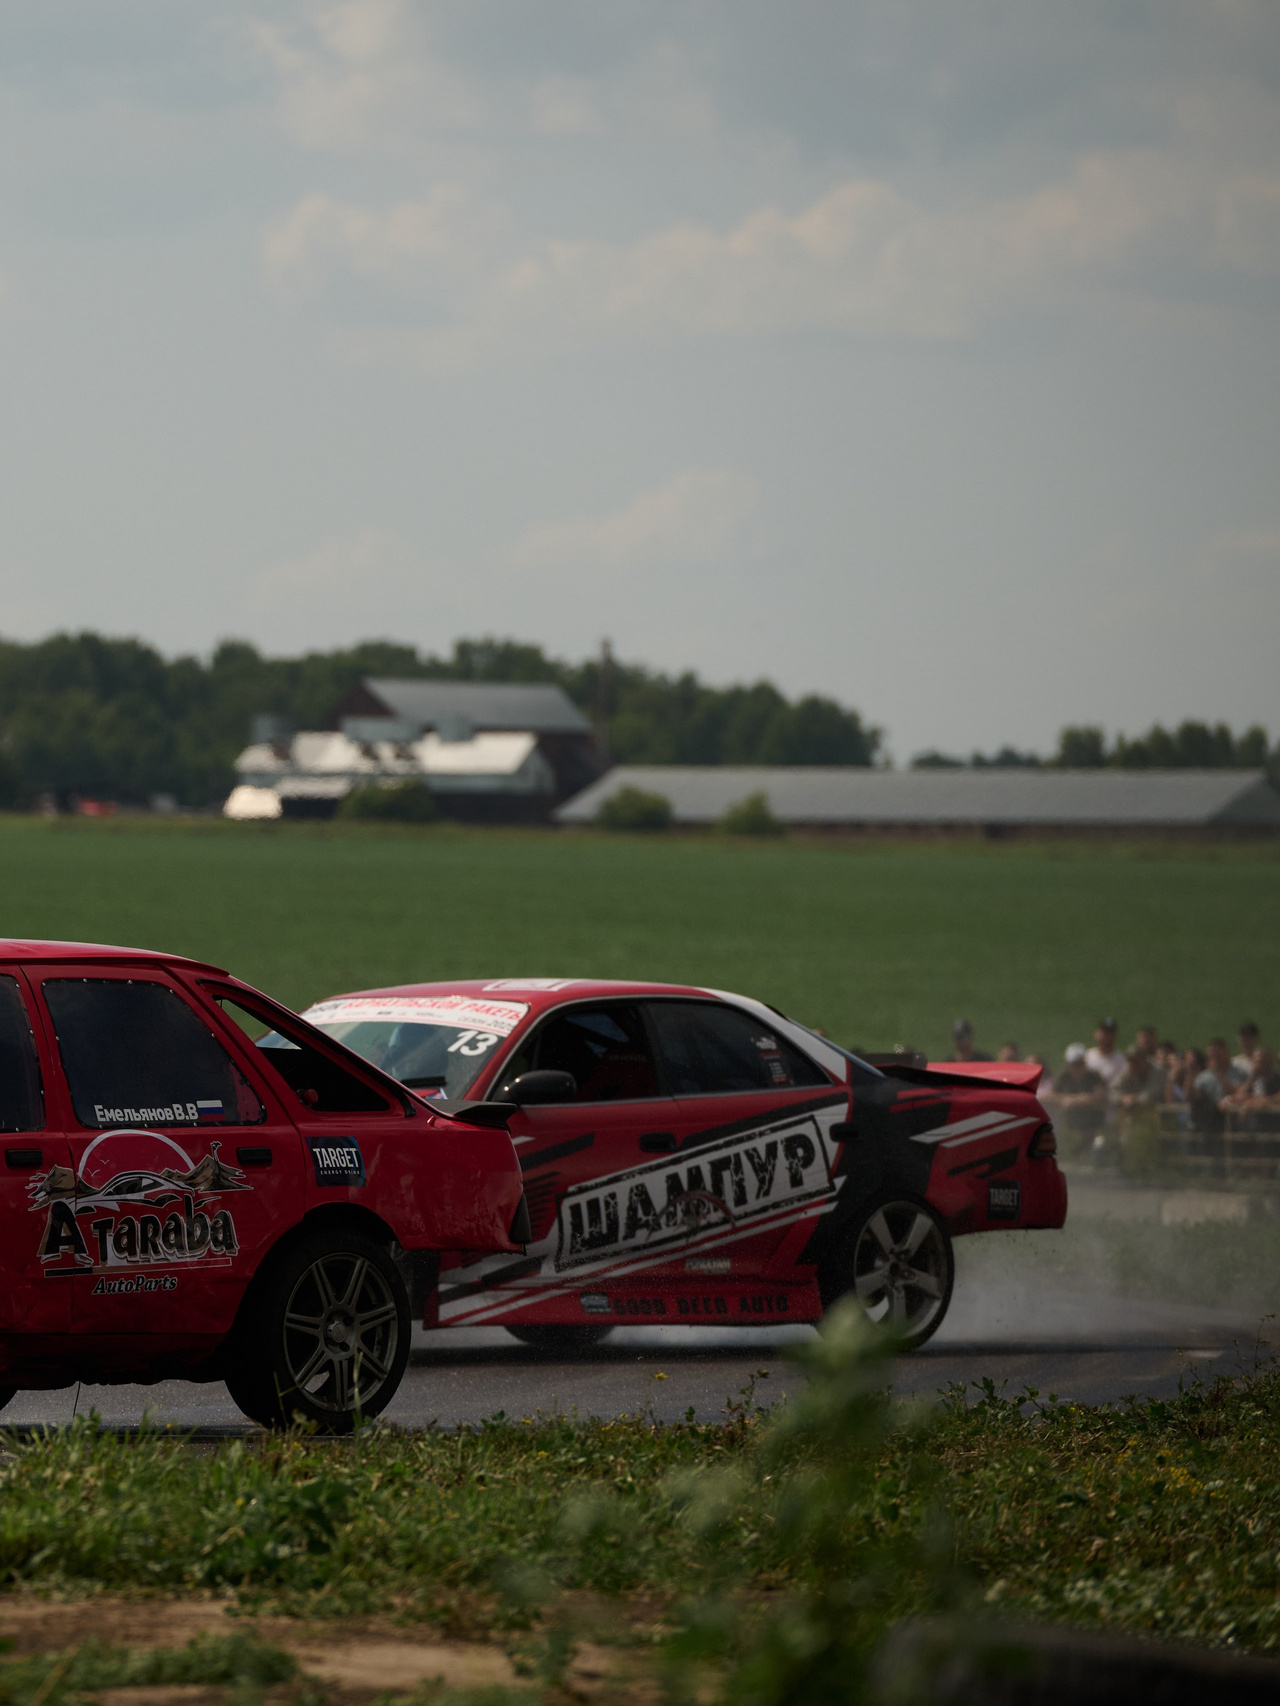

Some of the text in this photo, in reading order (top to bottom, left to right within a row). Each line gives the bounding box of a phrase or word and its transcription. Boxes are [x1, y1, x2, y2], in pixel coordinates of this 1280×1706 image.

[447, 1030, 498, 1056] 13
[312, 1147, 359, 1168] TARGET
[569, 1133, 816, 1254] ШАМПУР
[989, 1188, 1019, 1206] TARGET
[91, 1275, 178, 1294] AutoParts
[739, 1296, 789, 1314] AUTO
